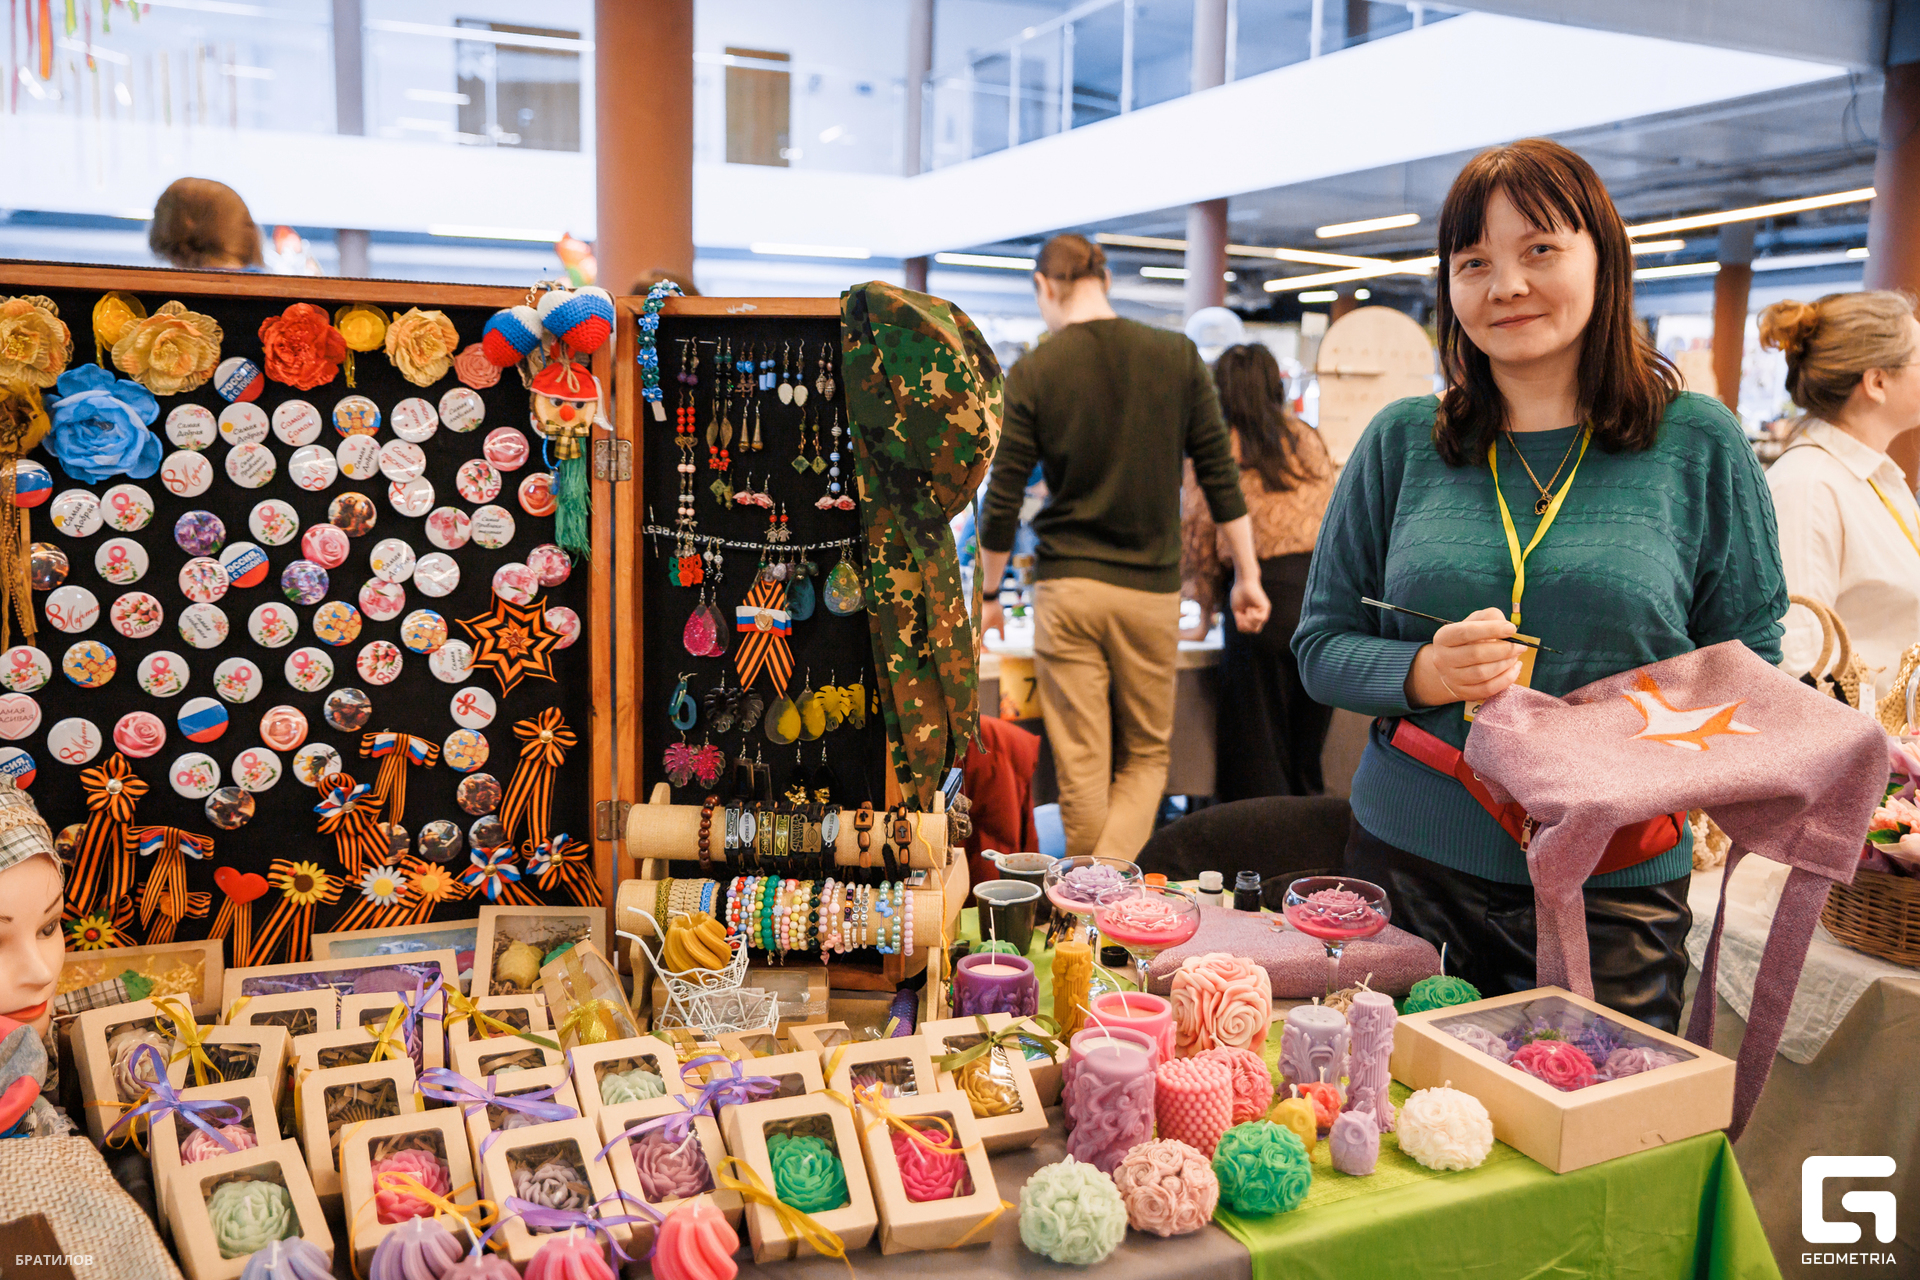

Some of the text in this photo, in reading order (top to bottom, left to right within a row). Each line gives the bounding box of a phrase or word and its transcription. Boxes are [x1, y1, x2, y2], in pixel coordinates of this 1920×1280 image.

[354, 447, 366, 469] Самая
[363, 446, 375, 473] Добрая
[161, 469, 187, 493] 8
[64, 502, 82, 526] Самая
[74, 504, 95, 531] Добрая
[226, 550, 260, 572] ОССИЯ,
[46, 604, 100, 630] 8 Марта
[122, 622, 133, 637] 8
[376, 672, 391, 684] 8
[0, 707, 25, 715] АМАЯ
[0, 715, 33, 723] АСИВАЯ
[59, 721, 94, 763] 8 Марта
[11, 763, 32, 778] БОЙ!
